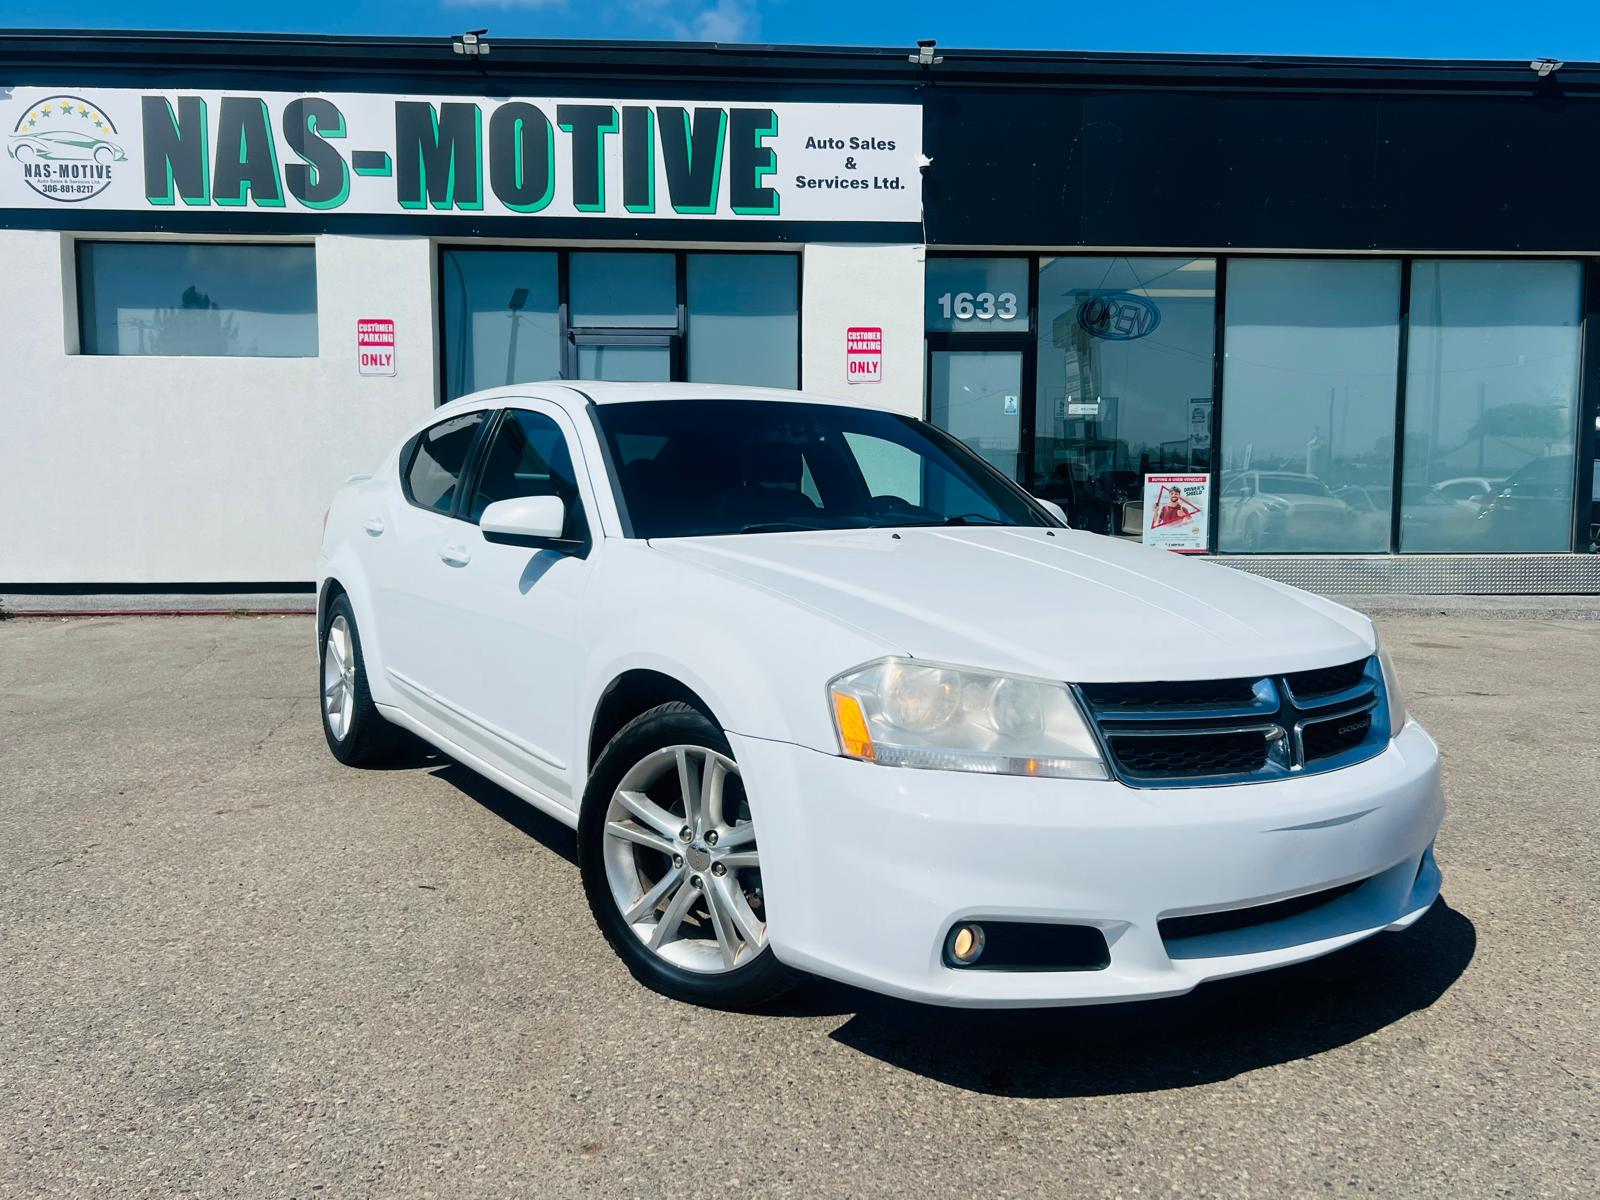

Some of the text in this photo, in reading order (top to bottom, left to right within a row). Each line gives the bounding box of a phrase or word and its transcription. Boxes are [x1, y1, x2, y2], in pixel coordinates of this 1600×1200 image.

[805, 136, 896, 151] Auto Sales
[141, 96, 780, 215] NAS-MOTIVE
[845, 156, 857, 170] &
[24, 164, 112, 179] NAS-MOTIVE
[42, 184, 94, 193] 306-881-8217
[796, 176, 905, 190] Services Ltd.
[938, 292, 1018, 320] 1633
[1085, 299, 1151, 336] OPEN
[358, 323, 393, 332] CUSTOMER
[359, 333, 394, 343] PARKING
[848, 331, 881, 340] CUSTOMER
[848, 341, 881, 350] PARKING
[361, 353, 392, 366] ONLY
[849, 361, 879, 374] ONLY
